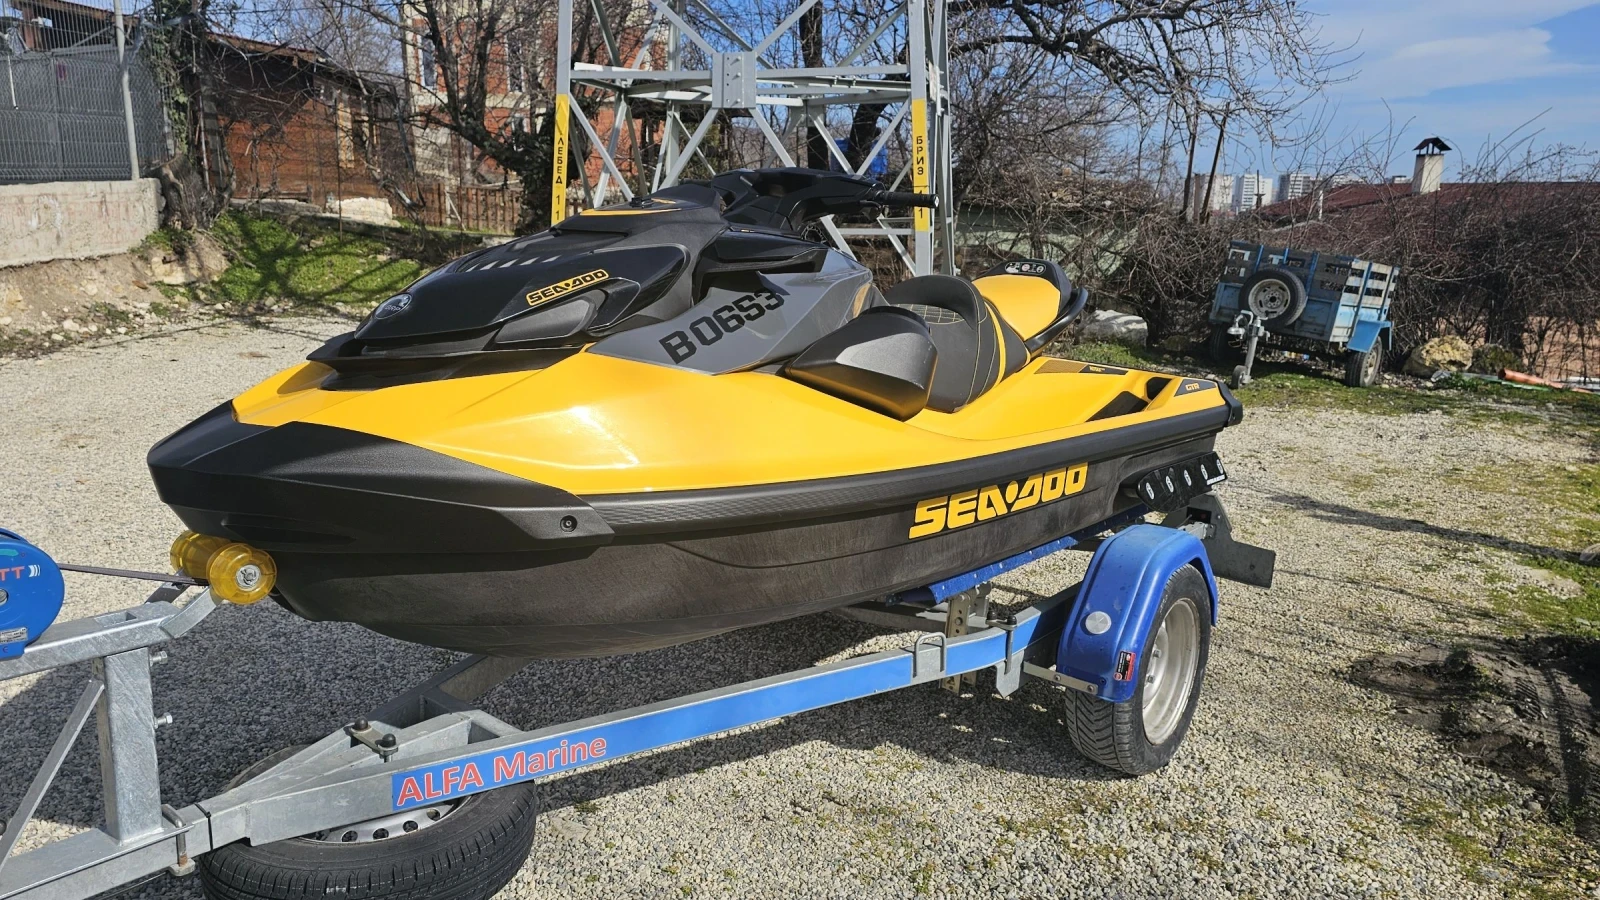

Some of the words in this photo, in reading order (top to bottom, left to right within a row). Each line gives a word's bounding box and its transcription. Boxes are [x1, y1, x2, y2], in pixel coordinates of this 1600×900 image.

[555, 137, 564, 184] ЛЕБЕД
[916, 136, 924, 175] БРИЗ
[396, 762, 484, 807] ALFA
[493, 737, 607, 783] Marine
